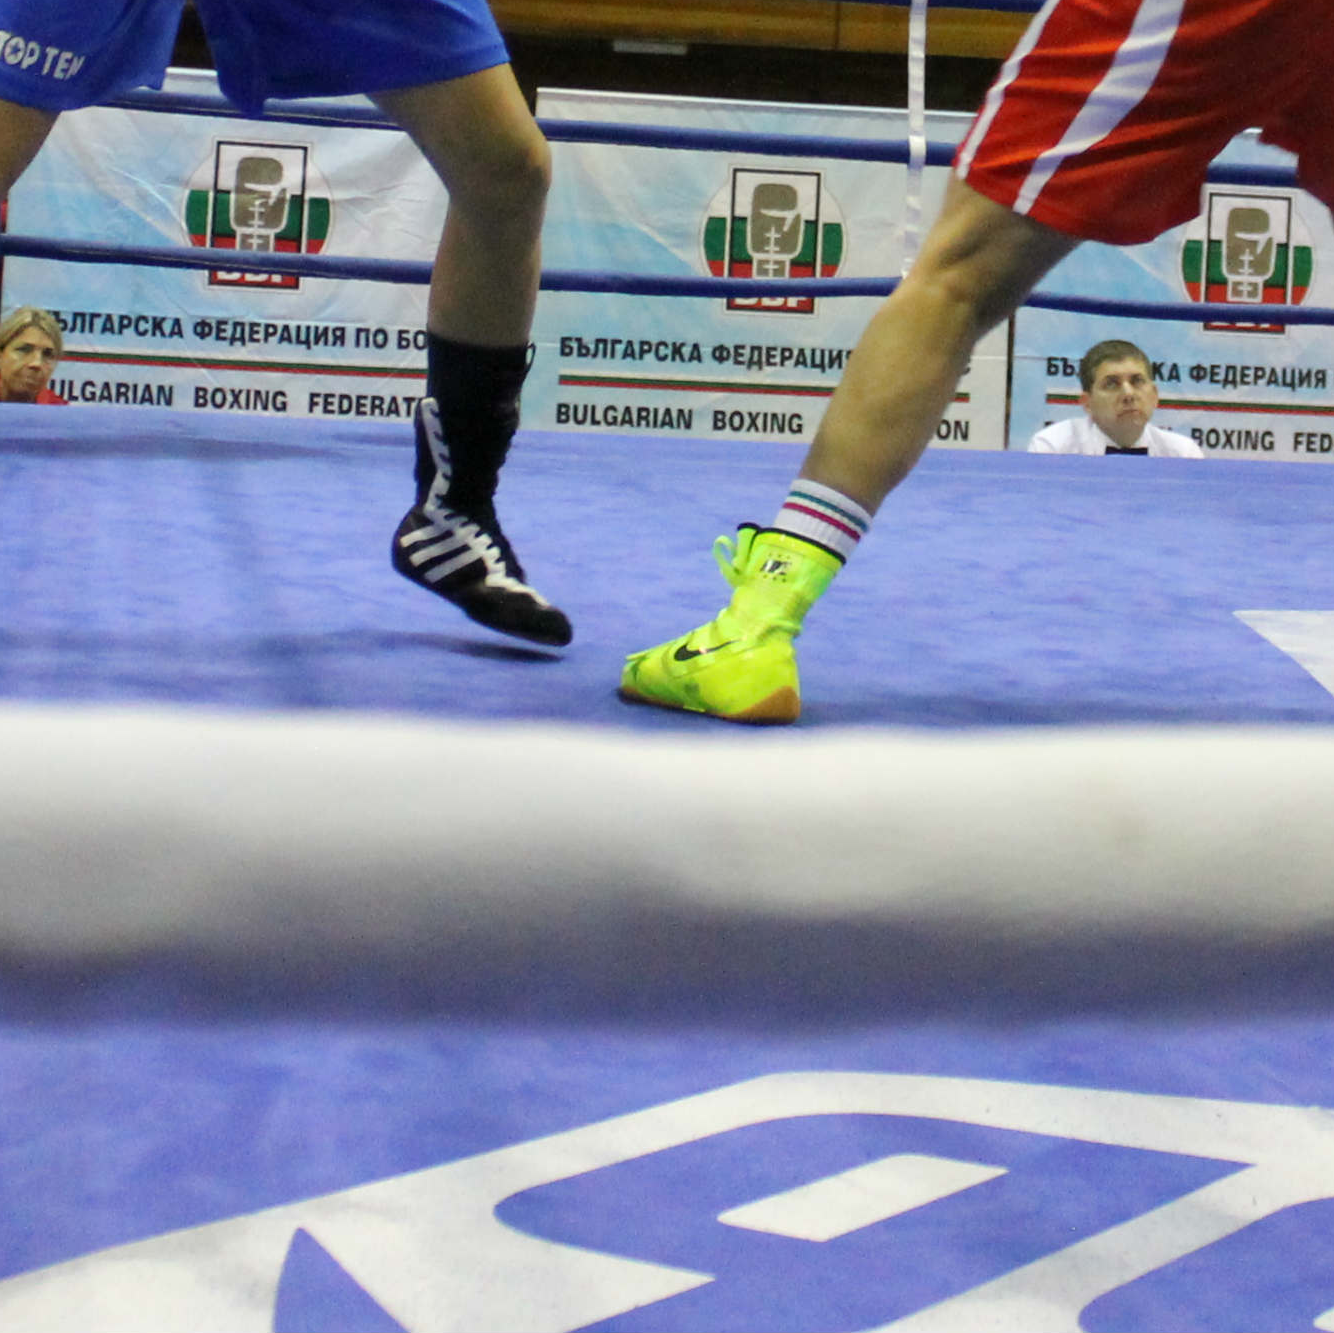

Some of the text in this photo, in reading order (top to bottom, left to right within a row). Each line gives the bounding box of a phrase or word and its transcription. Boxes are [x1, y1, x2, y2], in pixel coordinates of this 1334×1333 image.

[41, 46, 86, 81] TEN
[52, 310, 429, 351] ЪЛГАРСКА ФЕДЕРАЦИЯ ПО БО
[560, 336, 854, 373] БЪЛГАРСКА ФЕДЕРАЦИ
[1189, 364, 1327, 392] ФЕДЕРАЦИЯ
[50, 378, 420, 418] ULGARIAN BOXING FEDERAT
[556, 402, 804, 435] BULGARIAN BOXING
